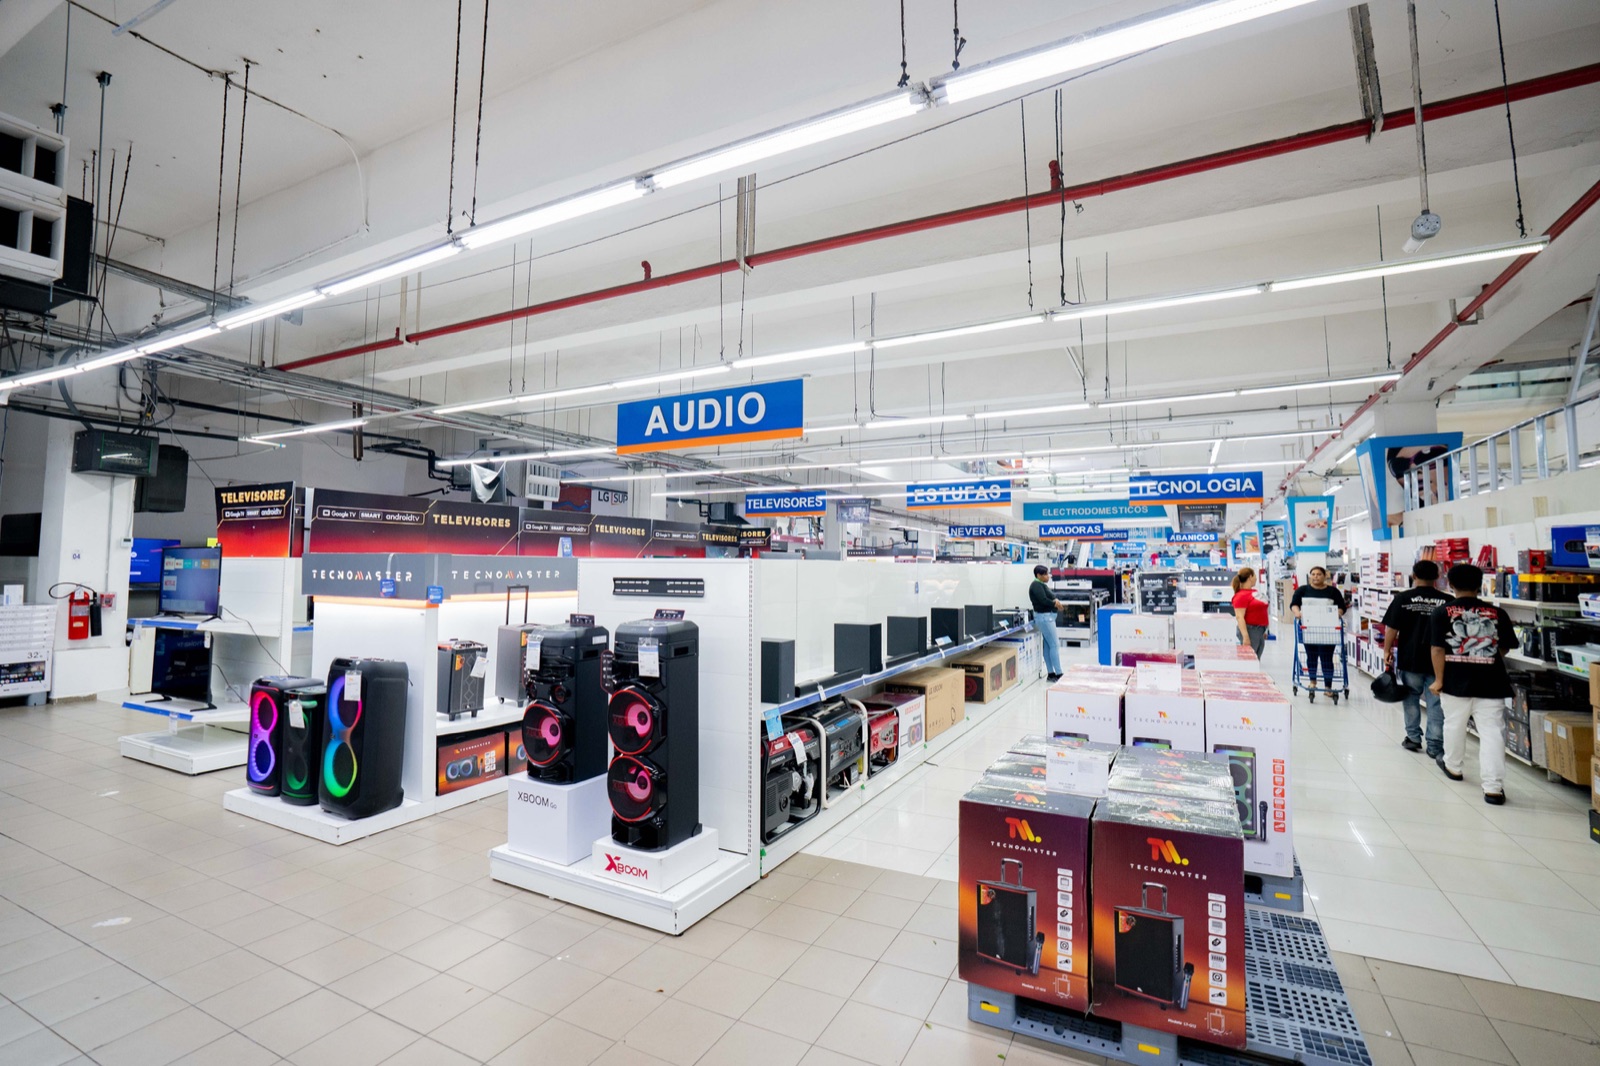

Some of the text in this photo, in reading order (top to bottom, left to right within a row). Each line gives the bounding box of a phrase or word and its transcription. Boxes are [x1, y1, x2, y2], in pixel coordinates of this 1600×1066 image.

[644, 391, 766, 436] AUDIO
[914, 484, 1001, 502] ESTUFAS
[1137, 478, 1256, 496] TECNOLOGIA
[221, 489, 286, 504] TELEVISORES
[598, 491, 610, 502] LG
[746, 496, 823, 510] TELEVISORES
[331, 510, 349, 518] Google
[386, 513, 420, 522] androidtv
[1042, 506, 1148, 516] ELECTRODOMESTICOS
[433, 514, 511, 528] TELEVISORES
[595, 524, 646, 536] TELEVISORES
[950, 527, 1003, 536] NEVERAS
[1041, 525, 1101, 535] LAVADORAS
[702, 533, 737, 543] TELEVISORES
[1170, 533, 1215, 541] ABANICOS
[312, 569, 413, 582] TECNOMASTER
[452, 569, 560, 580] TECNOMASTER
[1133, 717, 1197, 727] TECNOMASTER
[1214, 723, 1283, 733] TECNOMASTER
[517, 790, 549, 807] XBOOM
[990, 840, 1057, 857] TECNOMASTER
[604, 852, 648, 880] XBOOM
[1130, 863, 1207, 881] TECNOMASTER
